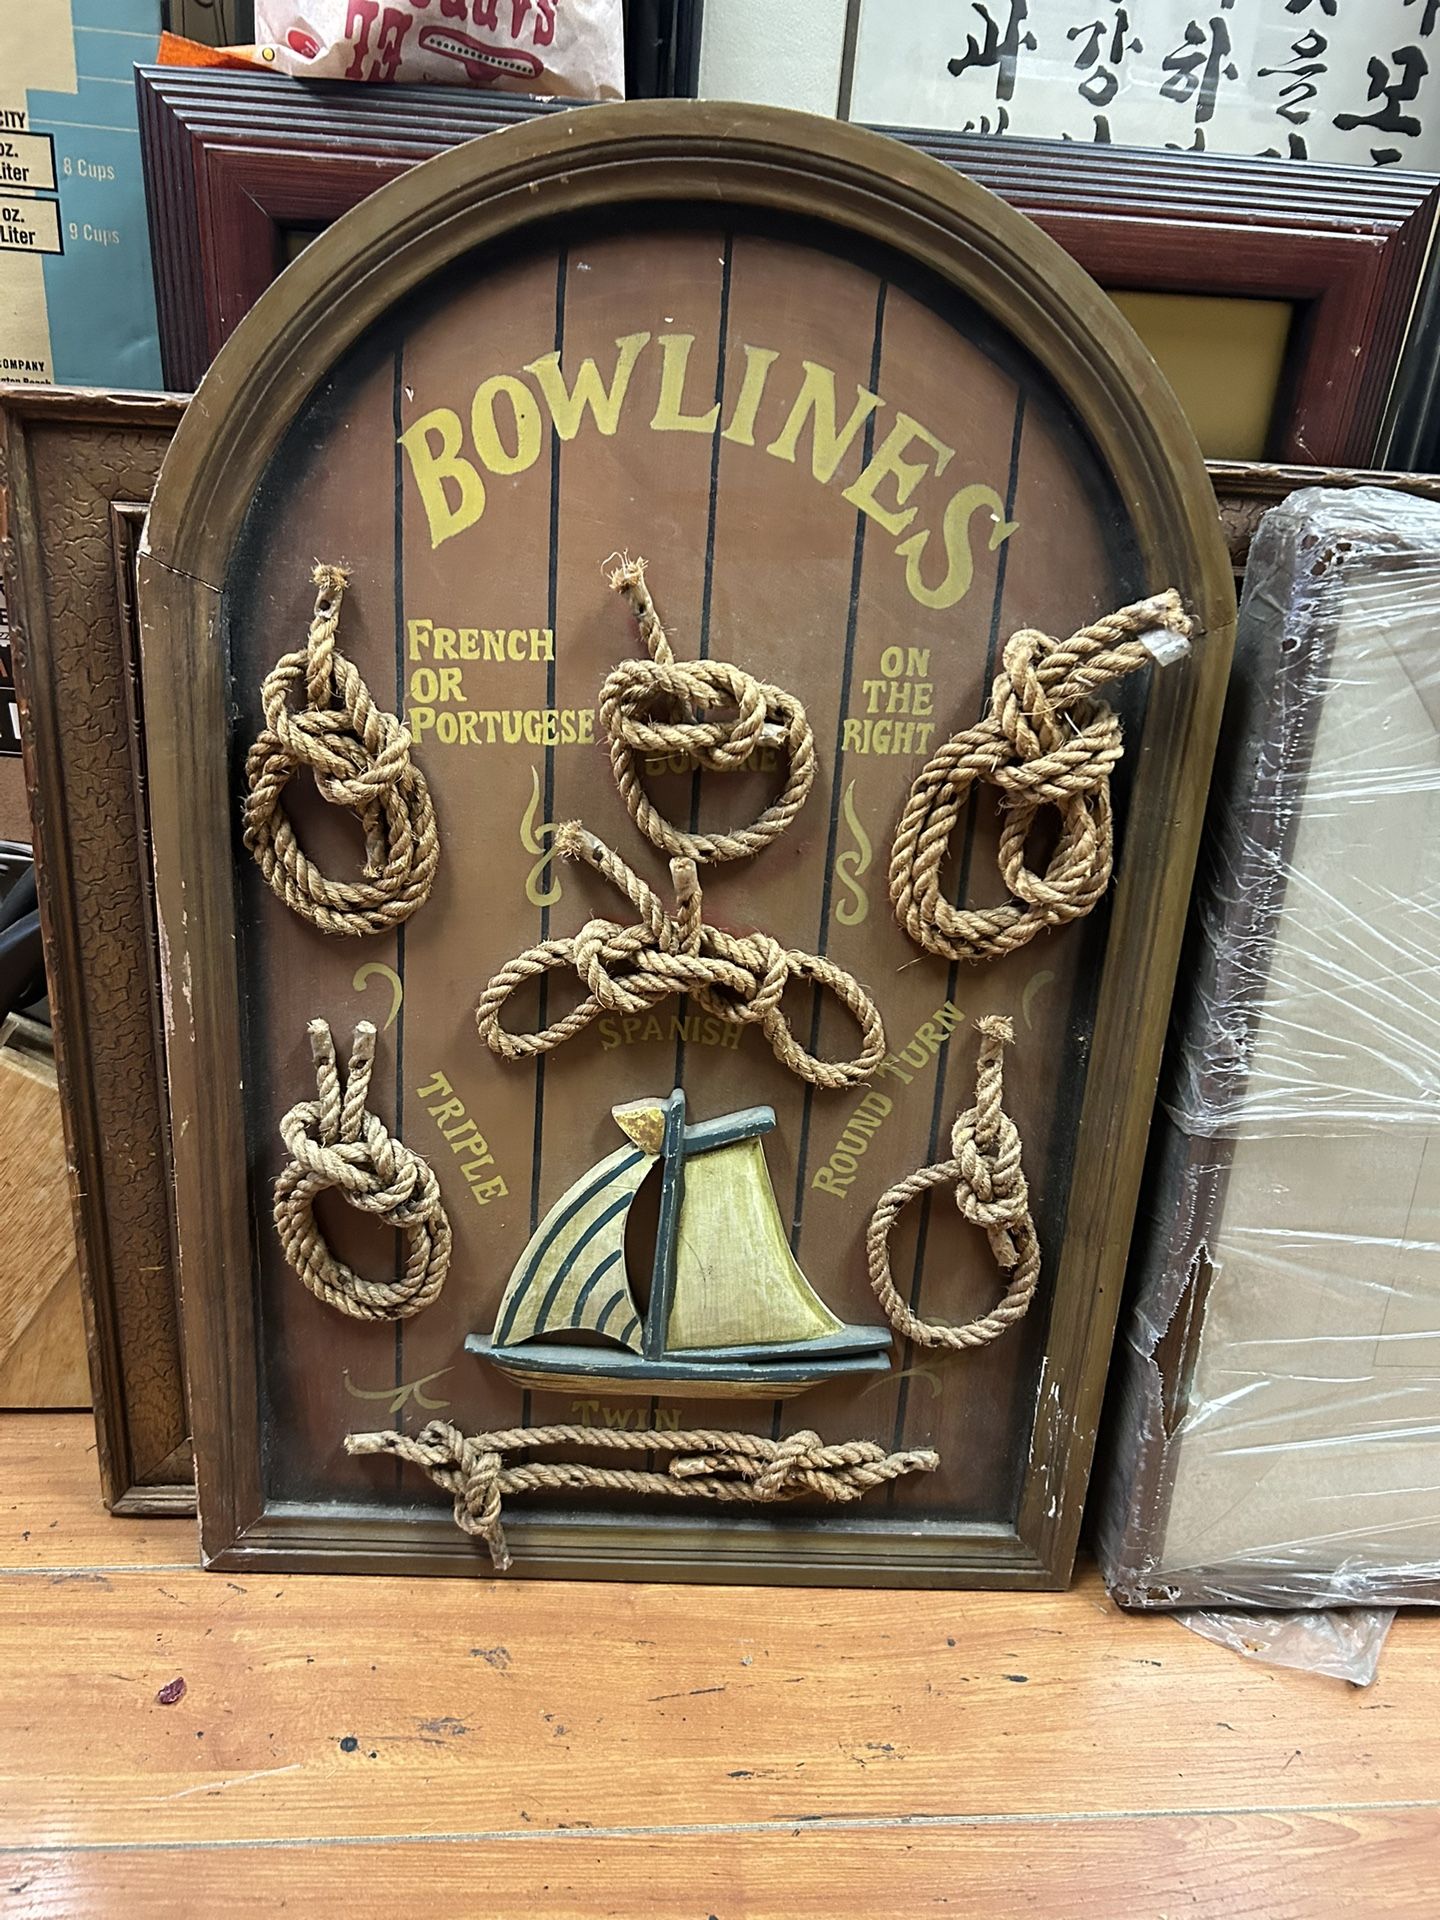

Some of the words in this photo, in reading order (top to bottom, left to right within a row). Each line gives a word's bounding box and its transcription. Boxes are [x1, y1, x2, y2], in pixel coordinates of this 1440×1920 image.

[63, 157, 72, 176] 8
[77, 159, 115, 182] Cups
[2, 207, 25, 223] oz.
[69, 222, 78, 240] 9
[83, 224, 120, 247] Cups
[0, 358, 45, 372] OMPANY
[398, 331, 1020, 609] BOWLINES
[407, 619, 555, 662] FRENCH
[880, 645, 931, 678] ON
[410, 667, 468, 704] OR
[862, 680, 934, 716] THE
[408, 707, 597, 746] PORTUGESE
[841, 718, 936, 756] RIGHT
[599, 1014, 744, 1051] SPANISH
[811, 1091, 894, 1199] ROUND
[875, 1000, 967, 1085] TURN
[416, 1070, 509, 1205] TRIPLE
[571, 1400, 682, 1432] TWIN
